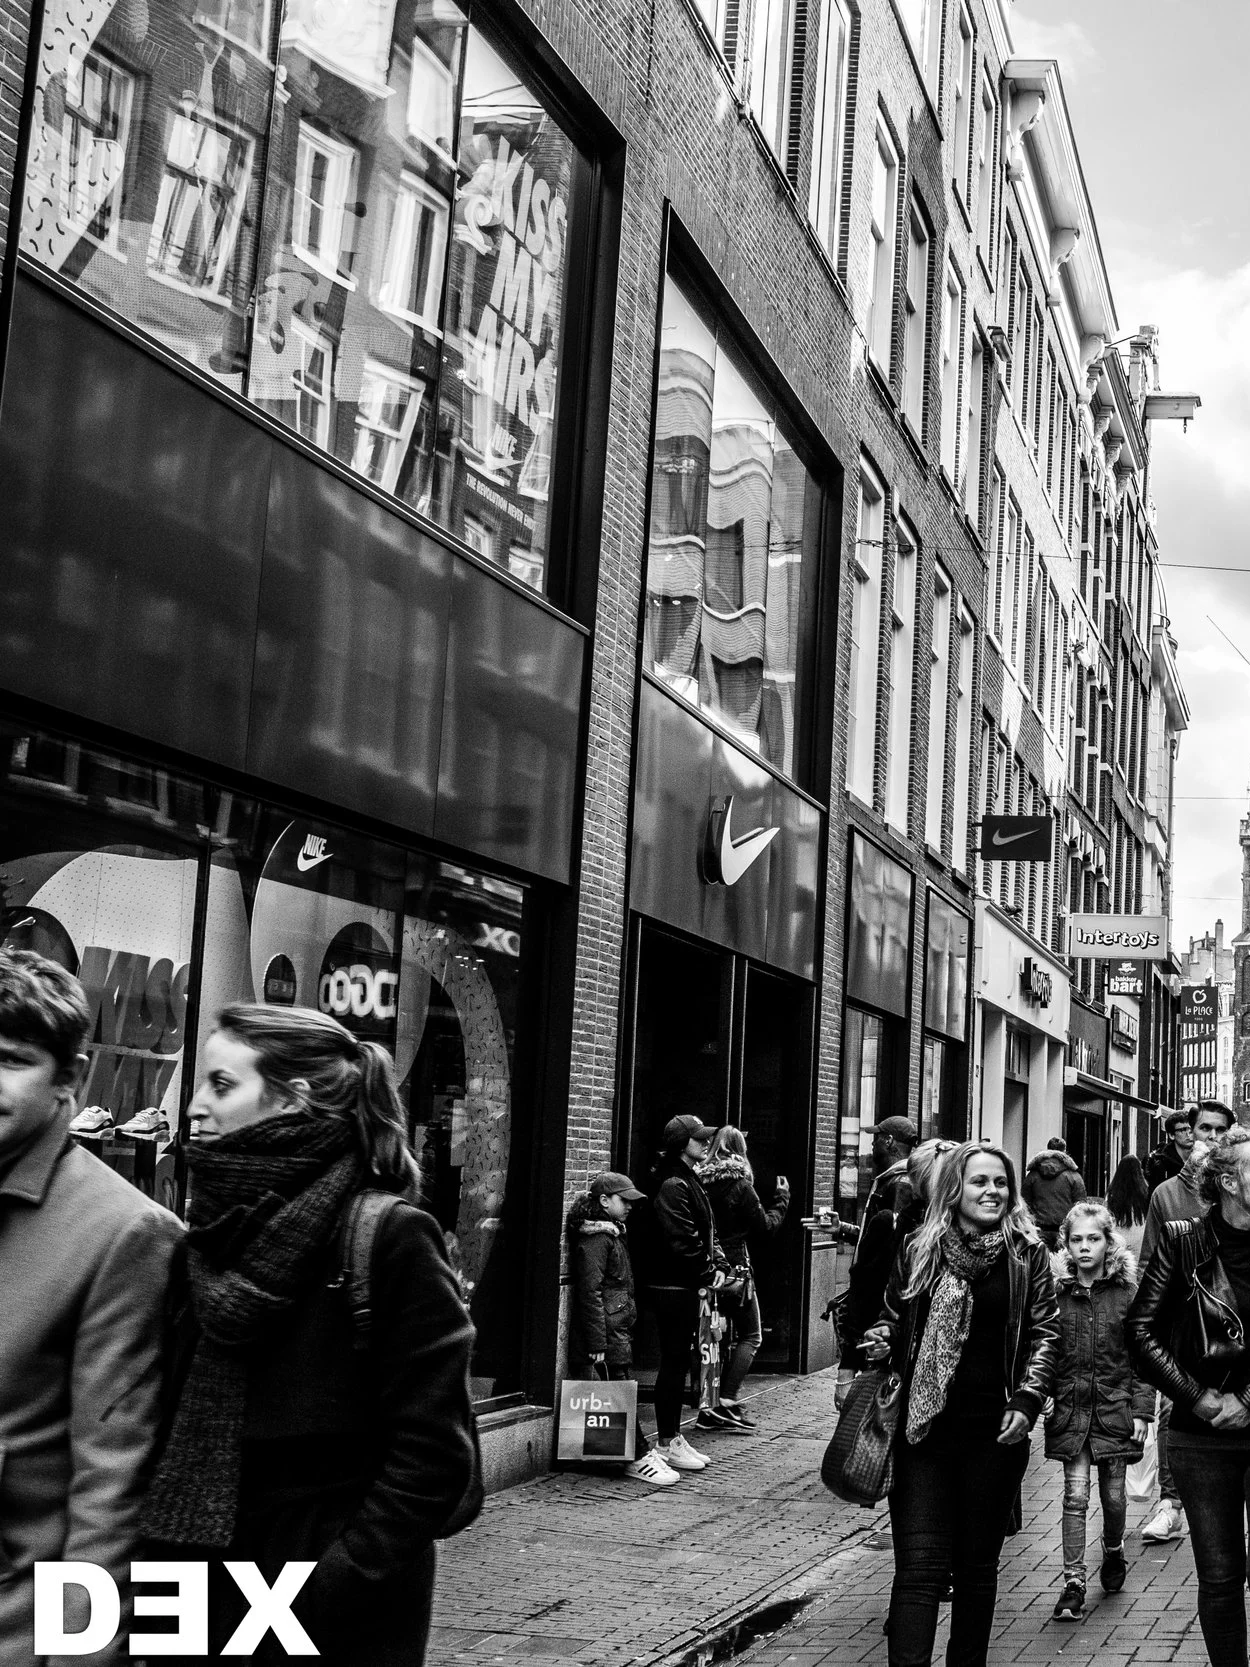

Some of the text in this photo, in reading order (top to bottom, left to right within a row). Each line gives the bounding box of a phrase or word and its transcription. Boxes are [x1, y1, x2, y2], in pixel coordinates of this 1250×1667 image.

[492, 134, 567, 272] KISS
[489, 230, 562, 346] MY
[468, 304, 557, 436] AIRS
[304, 833, 327, 857] NIKE
[1077, 928, 1159, 948] Intertoys
[1110, 978, 1143, 993] bart
[1193, 1006, 1213, 1015] PLACE
[570, 1393, 611, 1411] urb-
[587, 1414, 609, 1428] an
